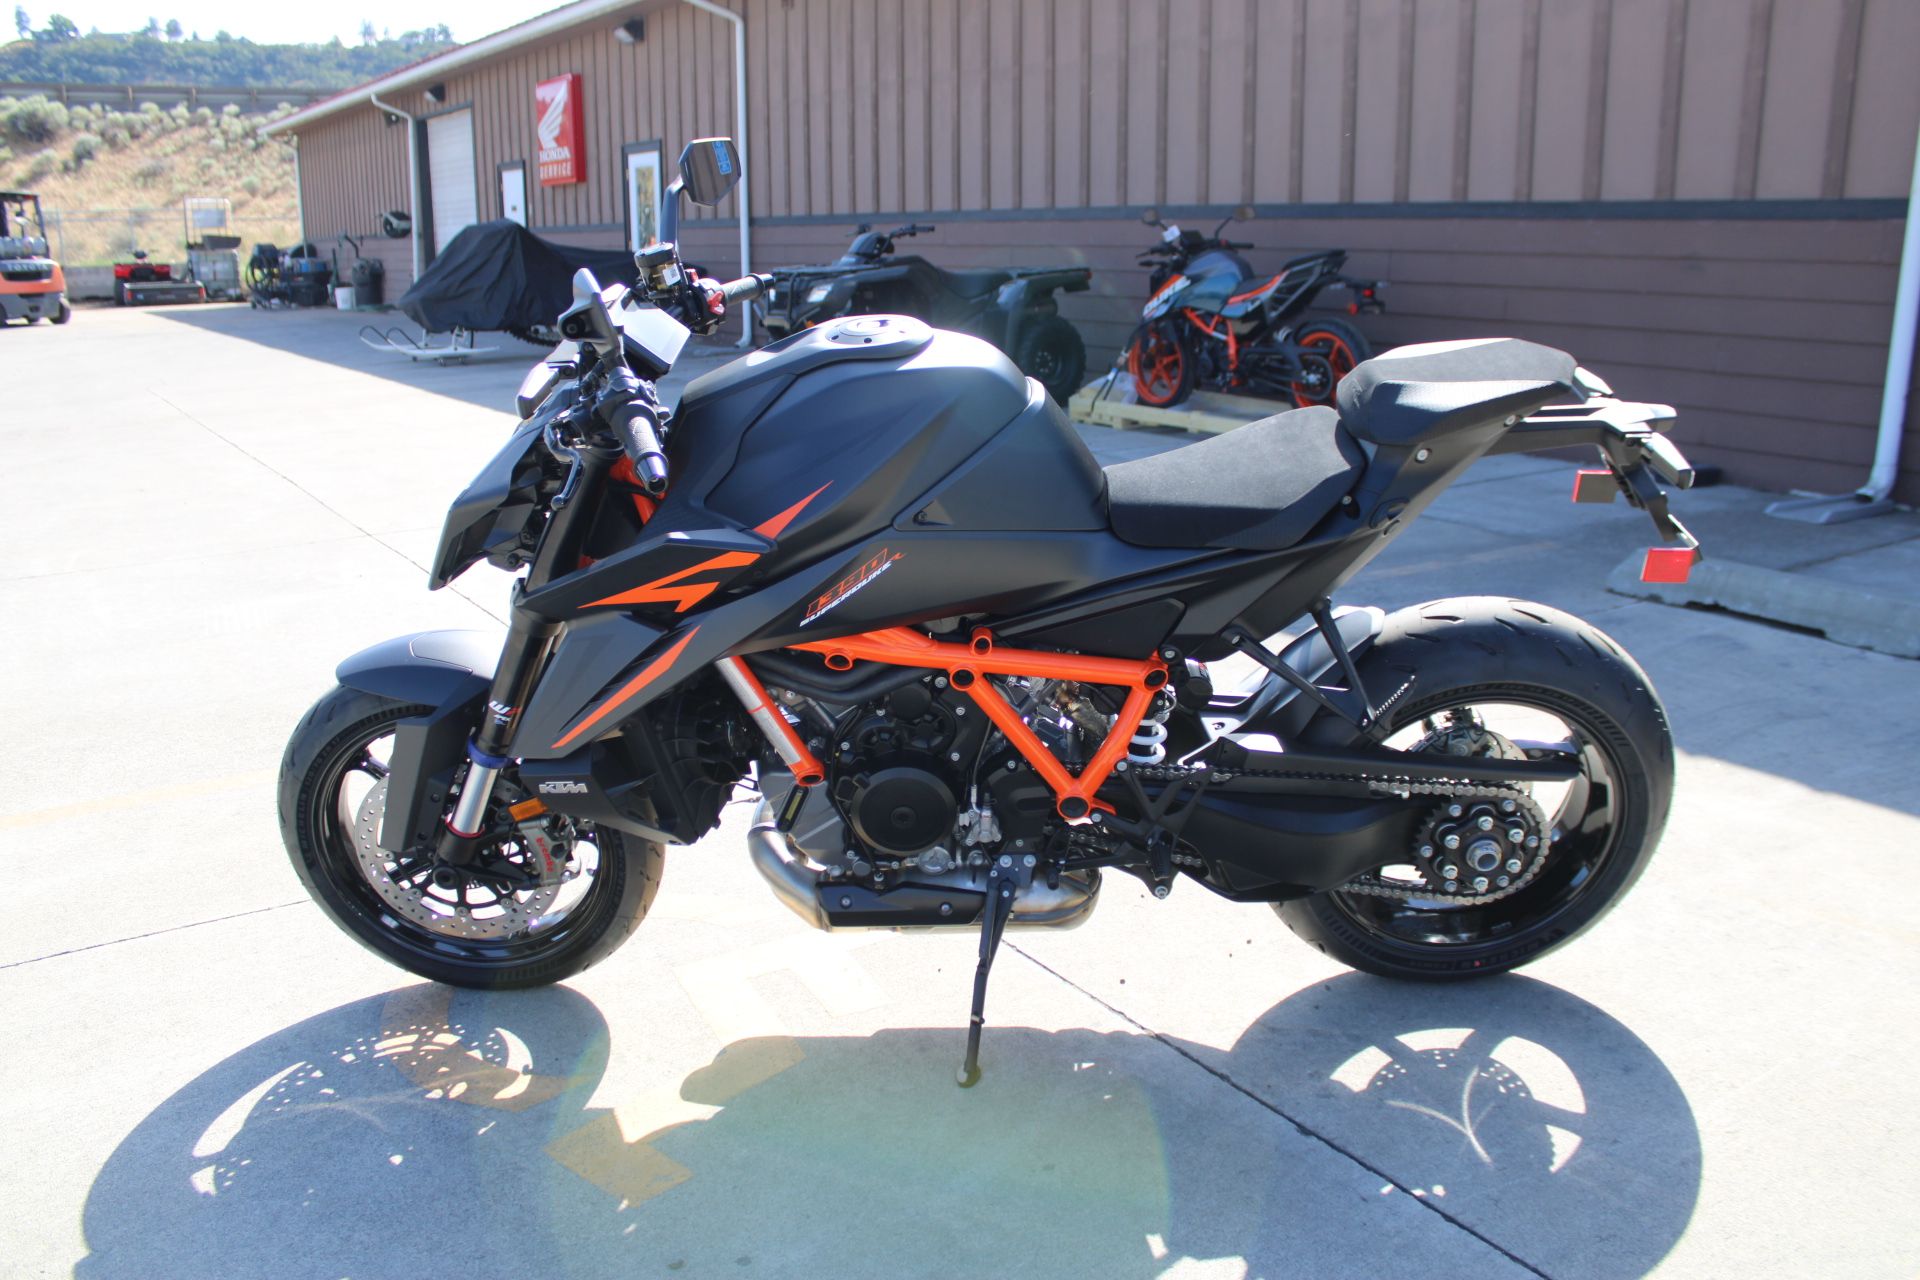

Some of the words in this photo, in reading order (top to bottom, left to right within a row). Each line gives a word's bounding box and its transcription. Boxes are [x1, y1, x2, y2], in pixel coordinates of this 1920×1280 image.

[539, 146, 571, 161] HONDA
[540, 160, 572, 180] SERVICE
[7, 263, 48, 271] TOYOTA
[539, 781, 588, 793] KTM
